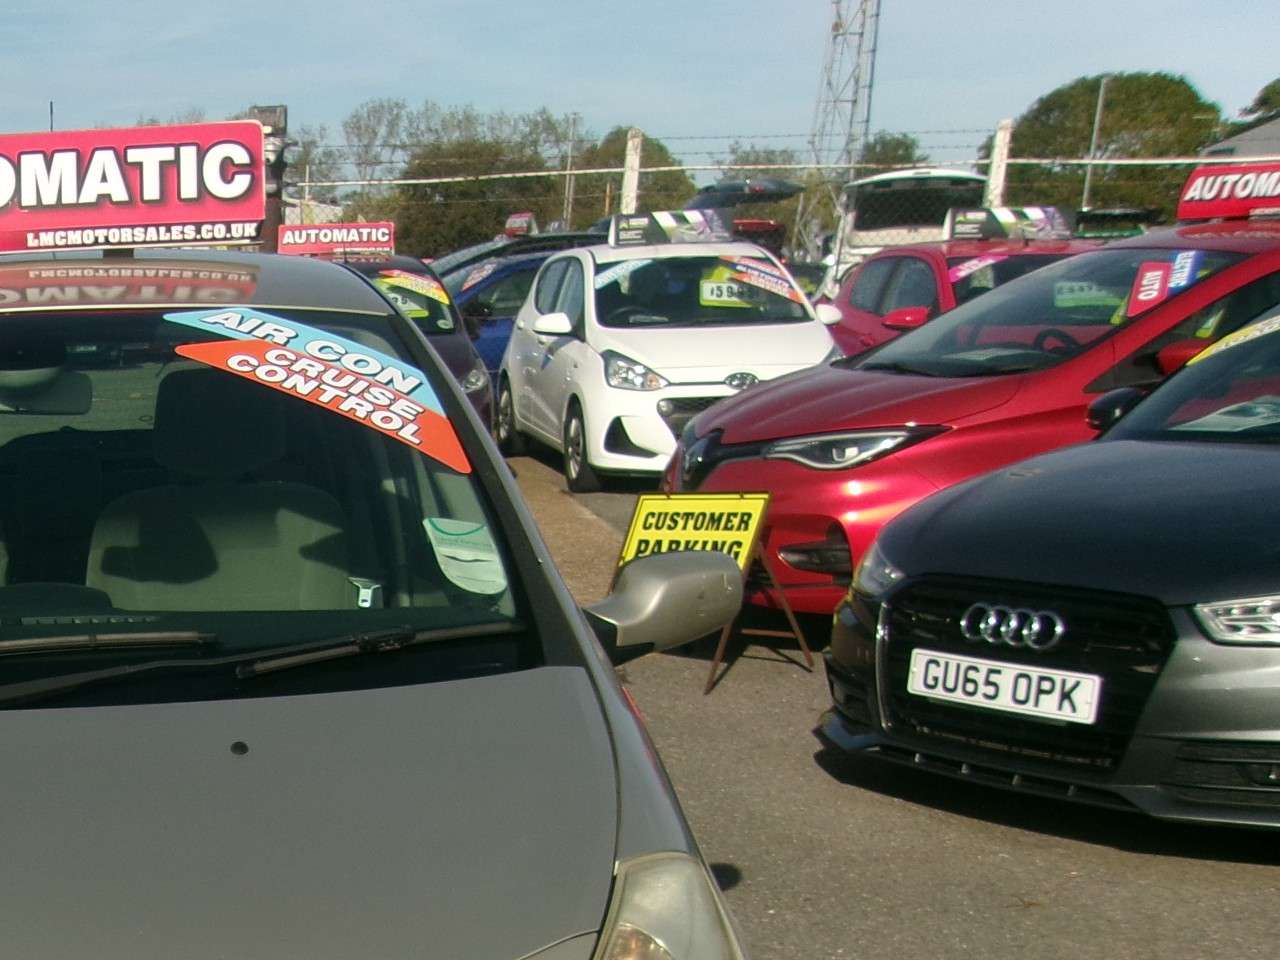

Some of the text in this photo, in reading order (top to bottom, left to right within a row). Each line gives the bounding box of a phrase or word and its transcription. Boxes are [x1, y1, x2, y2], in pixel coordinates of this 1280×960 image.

[26, 222, 258, 248] LMCMOTORSALES.CO.UK
[282, 228, 390, 245] AUTOMATIC
[1138, 270, 1165, 301] AUTO
[199, 309, 423, 395] AIR CON
[226, 353, 423, 445] CONTROL
[264, 348, 424, 421] CRUISE
[642, 511, 753, 531] CUSTOMER
[922, 658, 1081, 714] GU65 OPK
